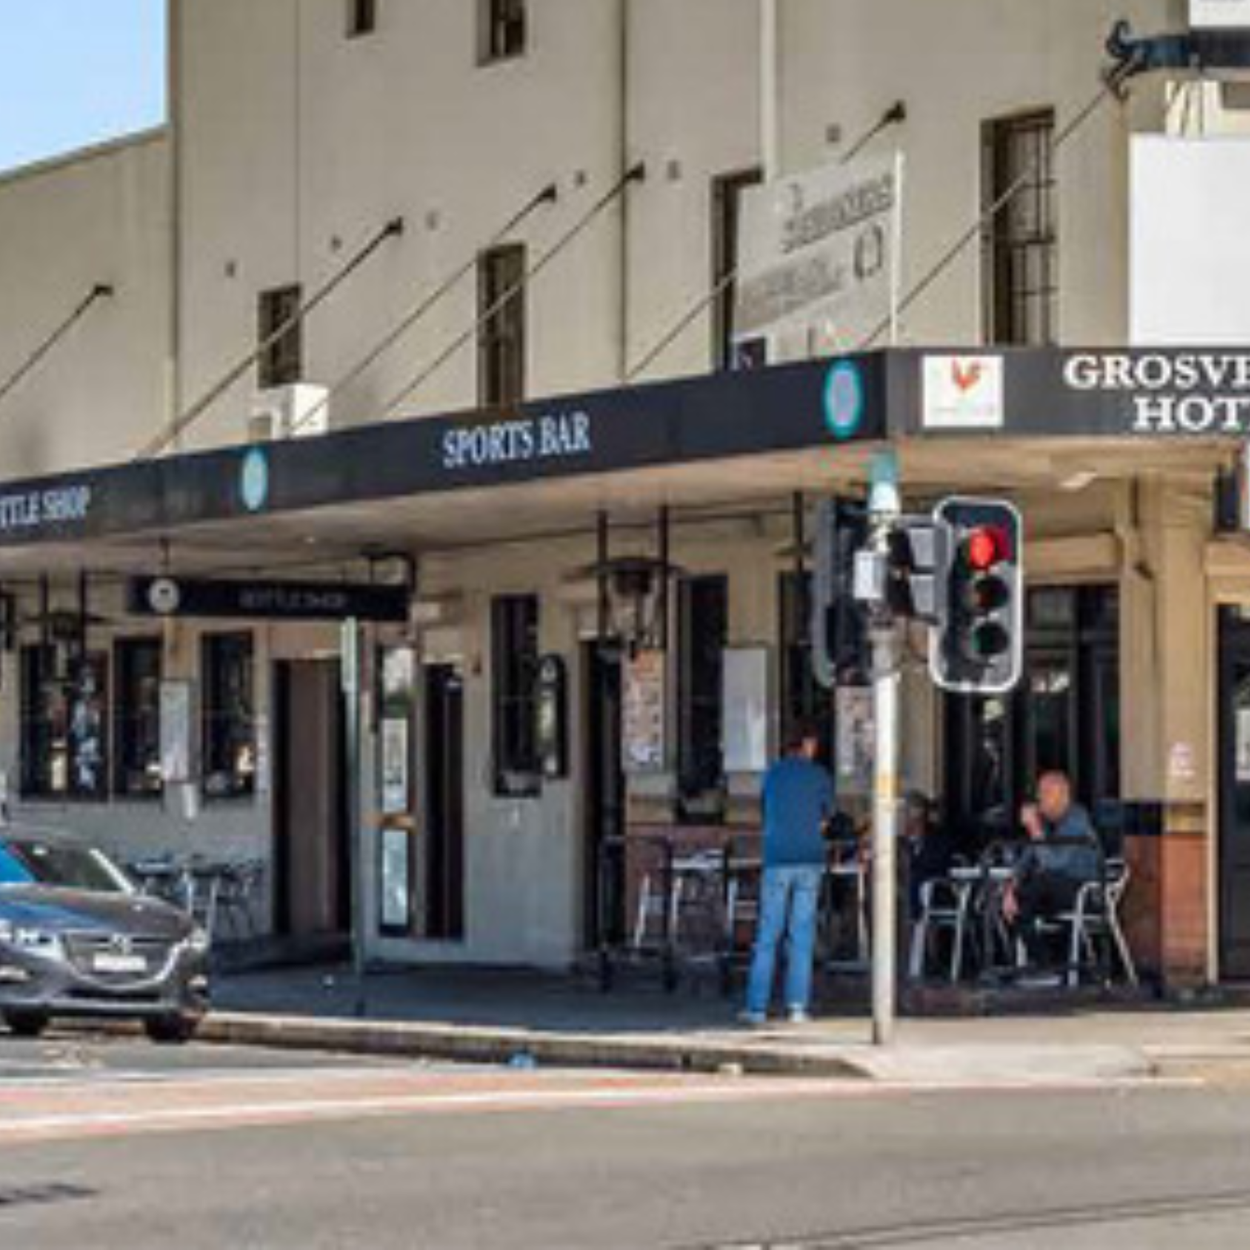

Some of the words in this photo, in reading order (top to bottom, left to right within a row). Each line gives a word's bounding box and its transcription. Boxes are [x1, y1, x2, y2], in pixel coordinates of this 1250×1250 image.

[443, 420, 534, 470] SPORTS
[540, 410, 592, 456] BAR
[42, 484, 92, 523] SHOP
